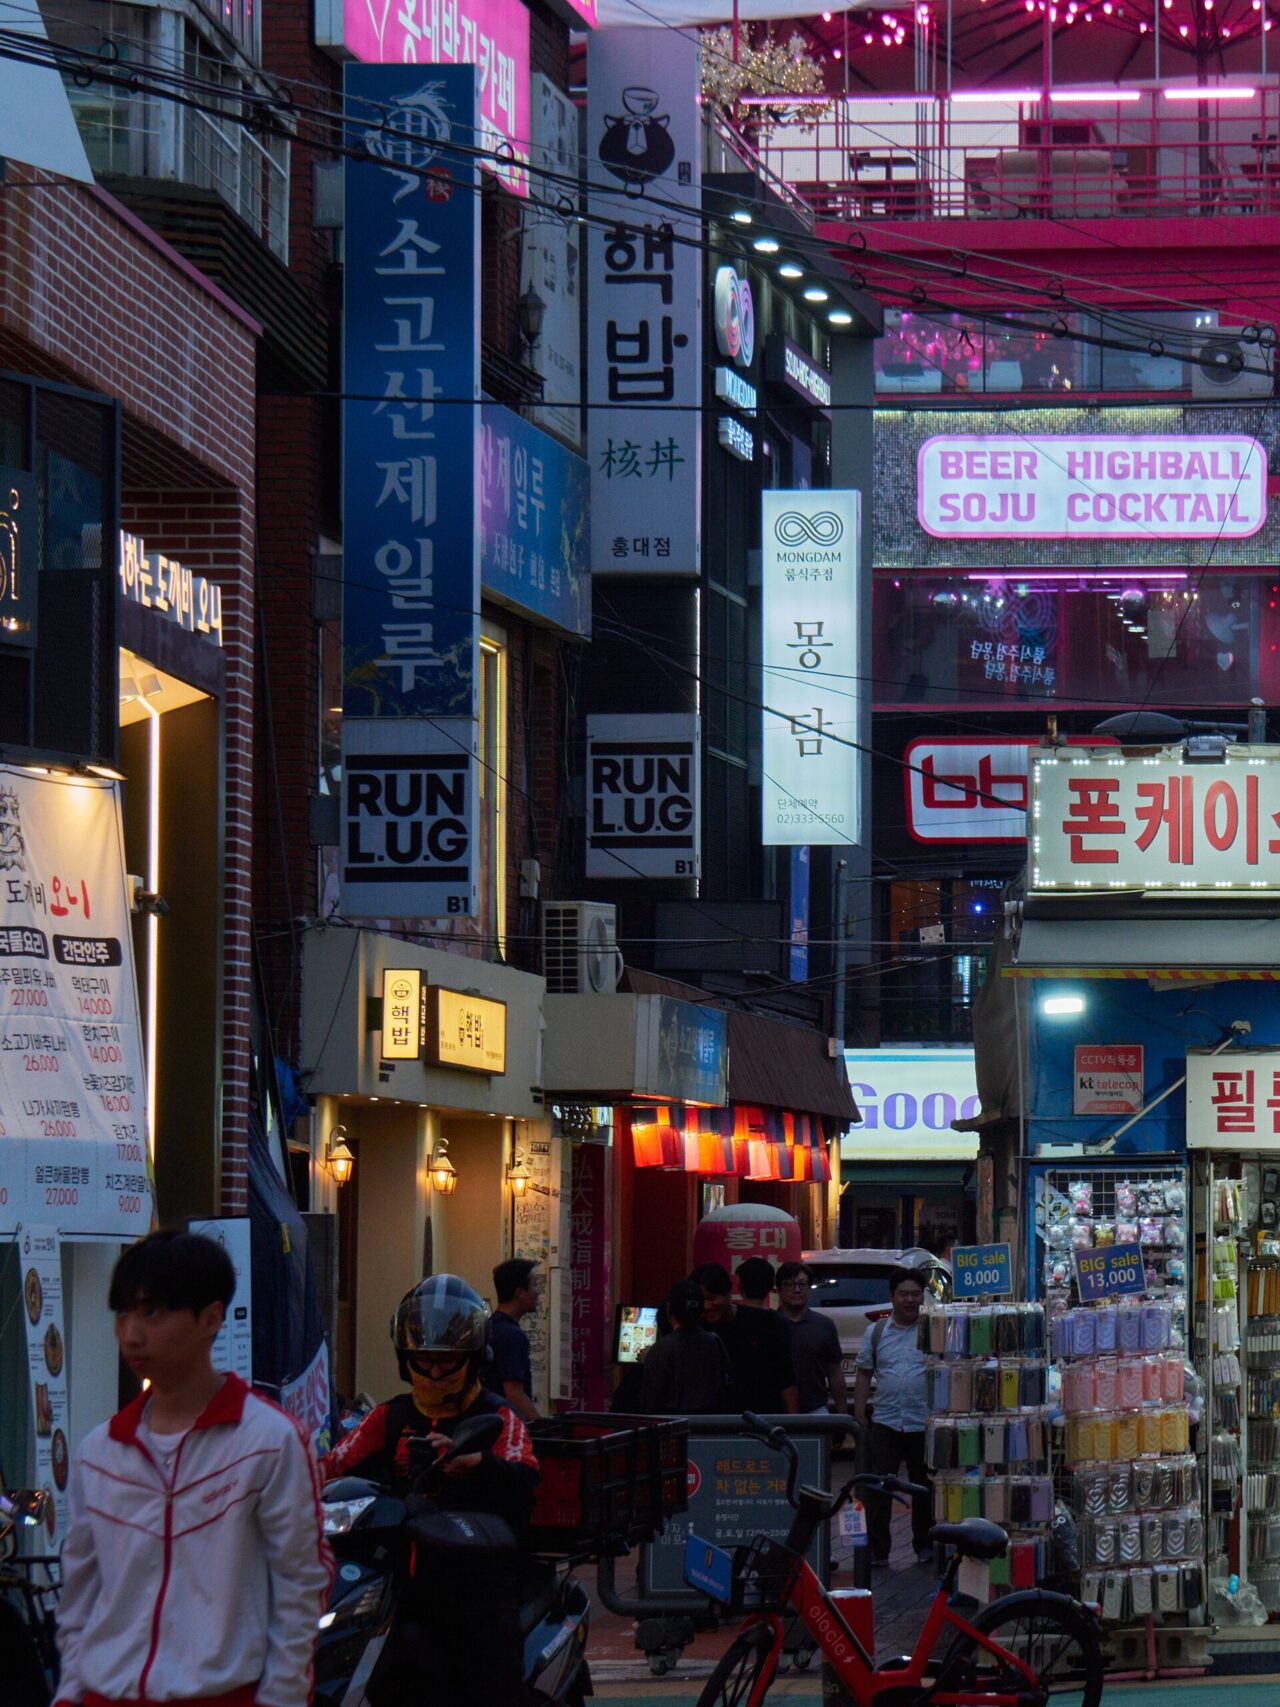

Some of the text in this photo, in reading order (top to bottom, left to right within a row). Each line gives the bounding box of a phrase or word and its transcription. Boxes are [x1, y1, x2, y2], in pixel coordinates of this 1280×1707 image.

[604, 220, 689, 402] 핵밥
[373, 219, 447, 694] 소고산제일루
[939, 450, 1251, 480] BEER HIGHBALL
[481, 424, 545, 536] 산제일루
[939, 492, 1250, 522] SOJU COCKTAIL
[611, 536, 671, 557] 홍대점
[776, 552, 842, 563] MONGDAM
[785, 567, 834, 582] 룸식주점
[121, 529, 153, 608] 하는
[197, 577, 224, 648] 오니
[786, 621, 834, 758] 몽담
[592, 758, 690, 794] RUN
[347, 773, 465, 817] RUN
[777, 798, 818, 810] 단체예약
[592, 795, 693, 833] L.U.G
[776, 812, 845, 826] 02)333-5560
[347, 818, 469, 865] L.U.G
[674, 859, 694, 875] B1
[50, 875, 91, 920] 오니
[446, 896, 470, 914] B1
[62, 940, 110, 964] 간단안주
[11, 989, 48, 1008] 27,000
[79, 997, 112, 1015] 14,000
[391, 1006, 412, 1046] 핵밥
[23, 1055, 59, 1073] 26,000
[1079, 1077, 1139, 1091] kt telecop
[849, 1082, 982, 1131] Goo
[41, 1120, 77, 1137] 26,000
[46, 1188, 79, 1206] 27,000
[118, 1196, 142, 1214] 9,000
[724, 1226, 788, 1250] 홍대
[956, 1250, 1007, 1268] BIG sale
[1079, 1252, 1140, 1274] BIG sale
[963, 1269, 1000, 1287] 8,000
[1087, 1267, 1137, 1289] 13,000
[809, 1604, 846, 1657] elecle
